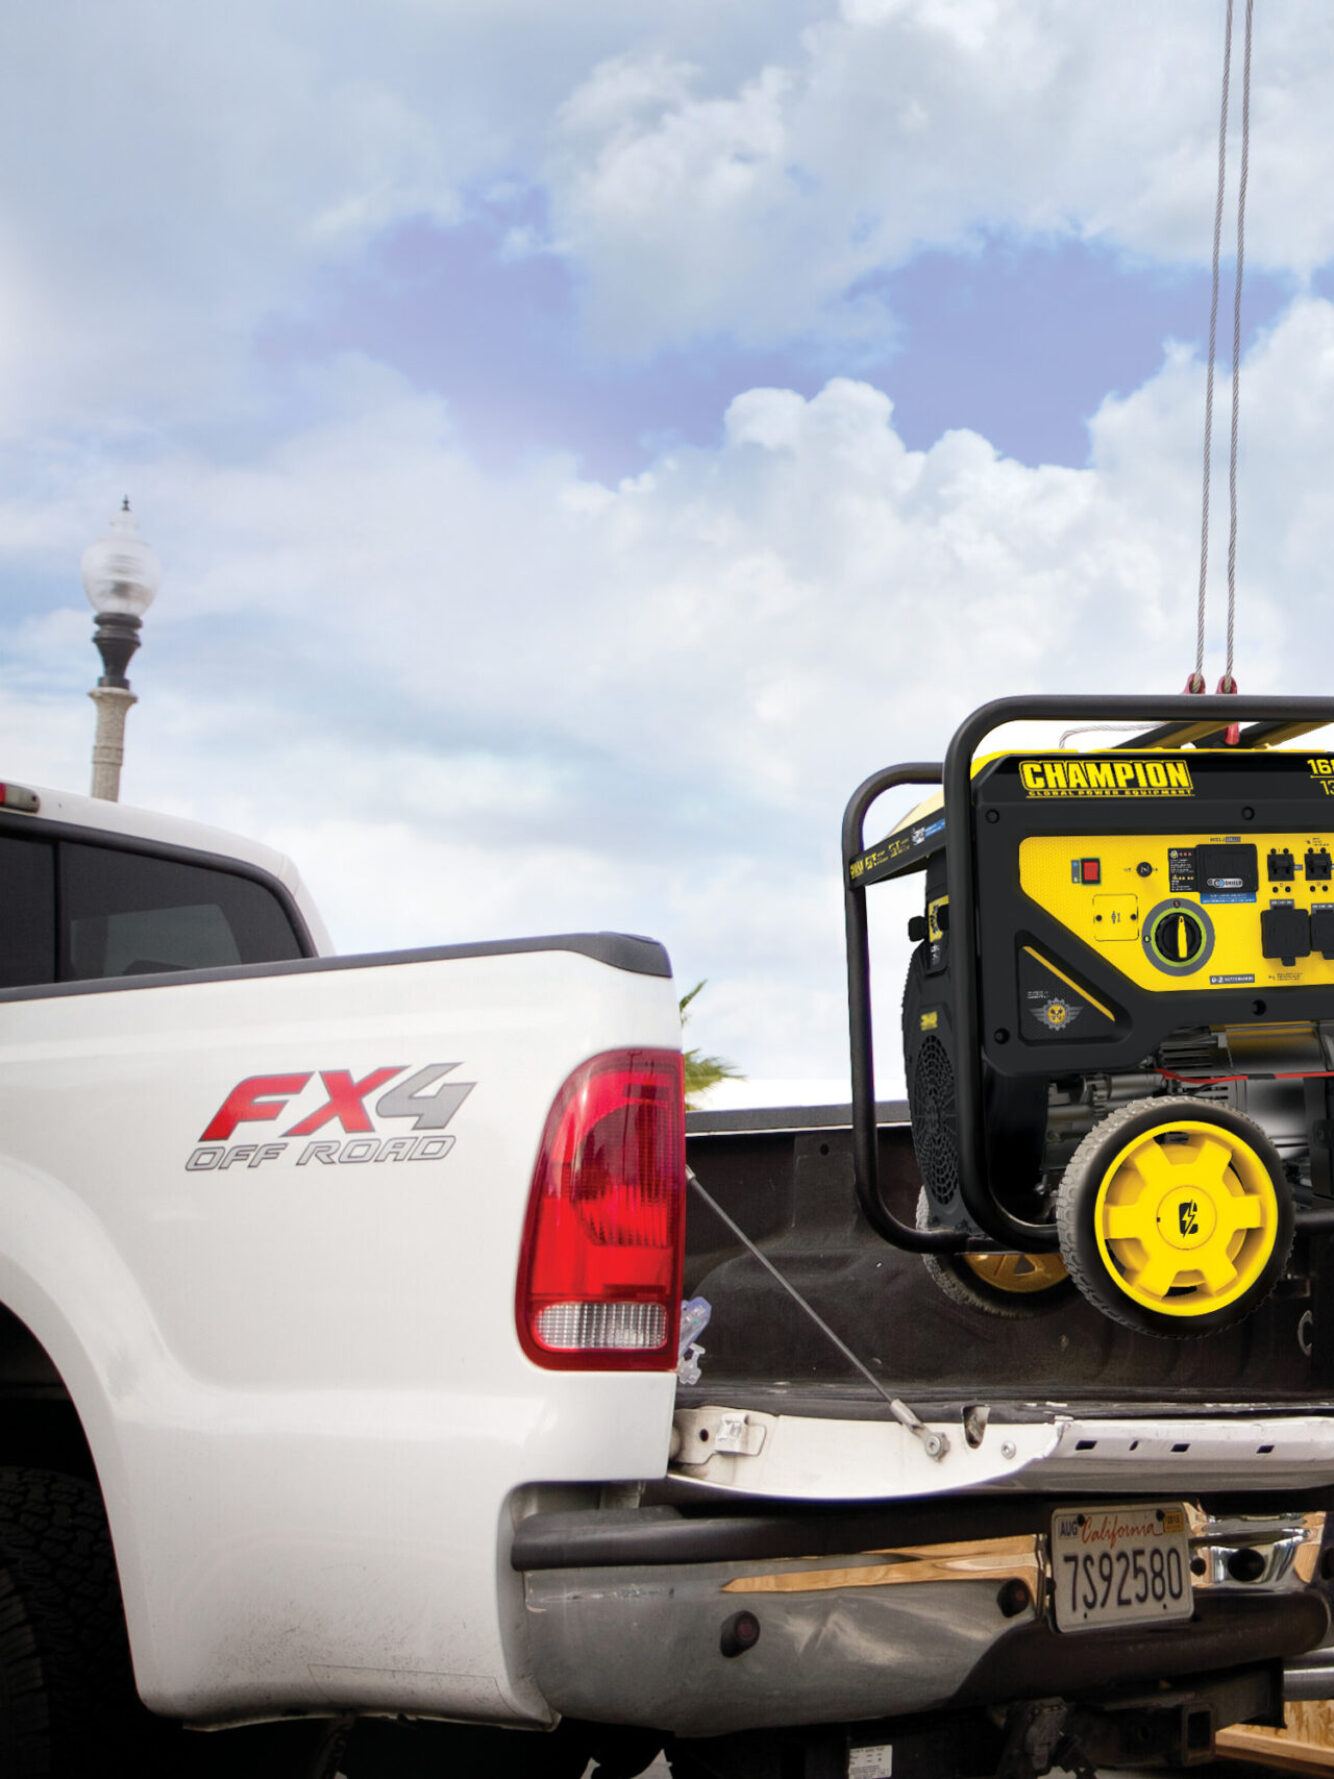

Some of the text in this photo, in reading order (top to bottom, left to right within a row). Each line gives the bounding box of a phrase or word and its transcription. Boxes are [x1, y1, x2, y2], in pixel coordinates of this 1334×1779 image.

[1020, 761, 1191, 789] CHAMPION
[199, 1062, 477, 1142] FX4
[184, 1135, 457, 1172] OFF ROAD
[1060, 1519, 1078, 1537] AUG
[1081, 1515, 1163, 1549] California
[1063, 1547, 1183, 1612] 7S92580
